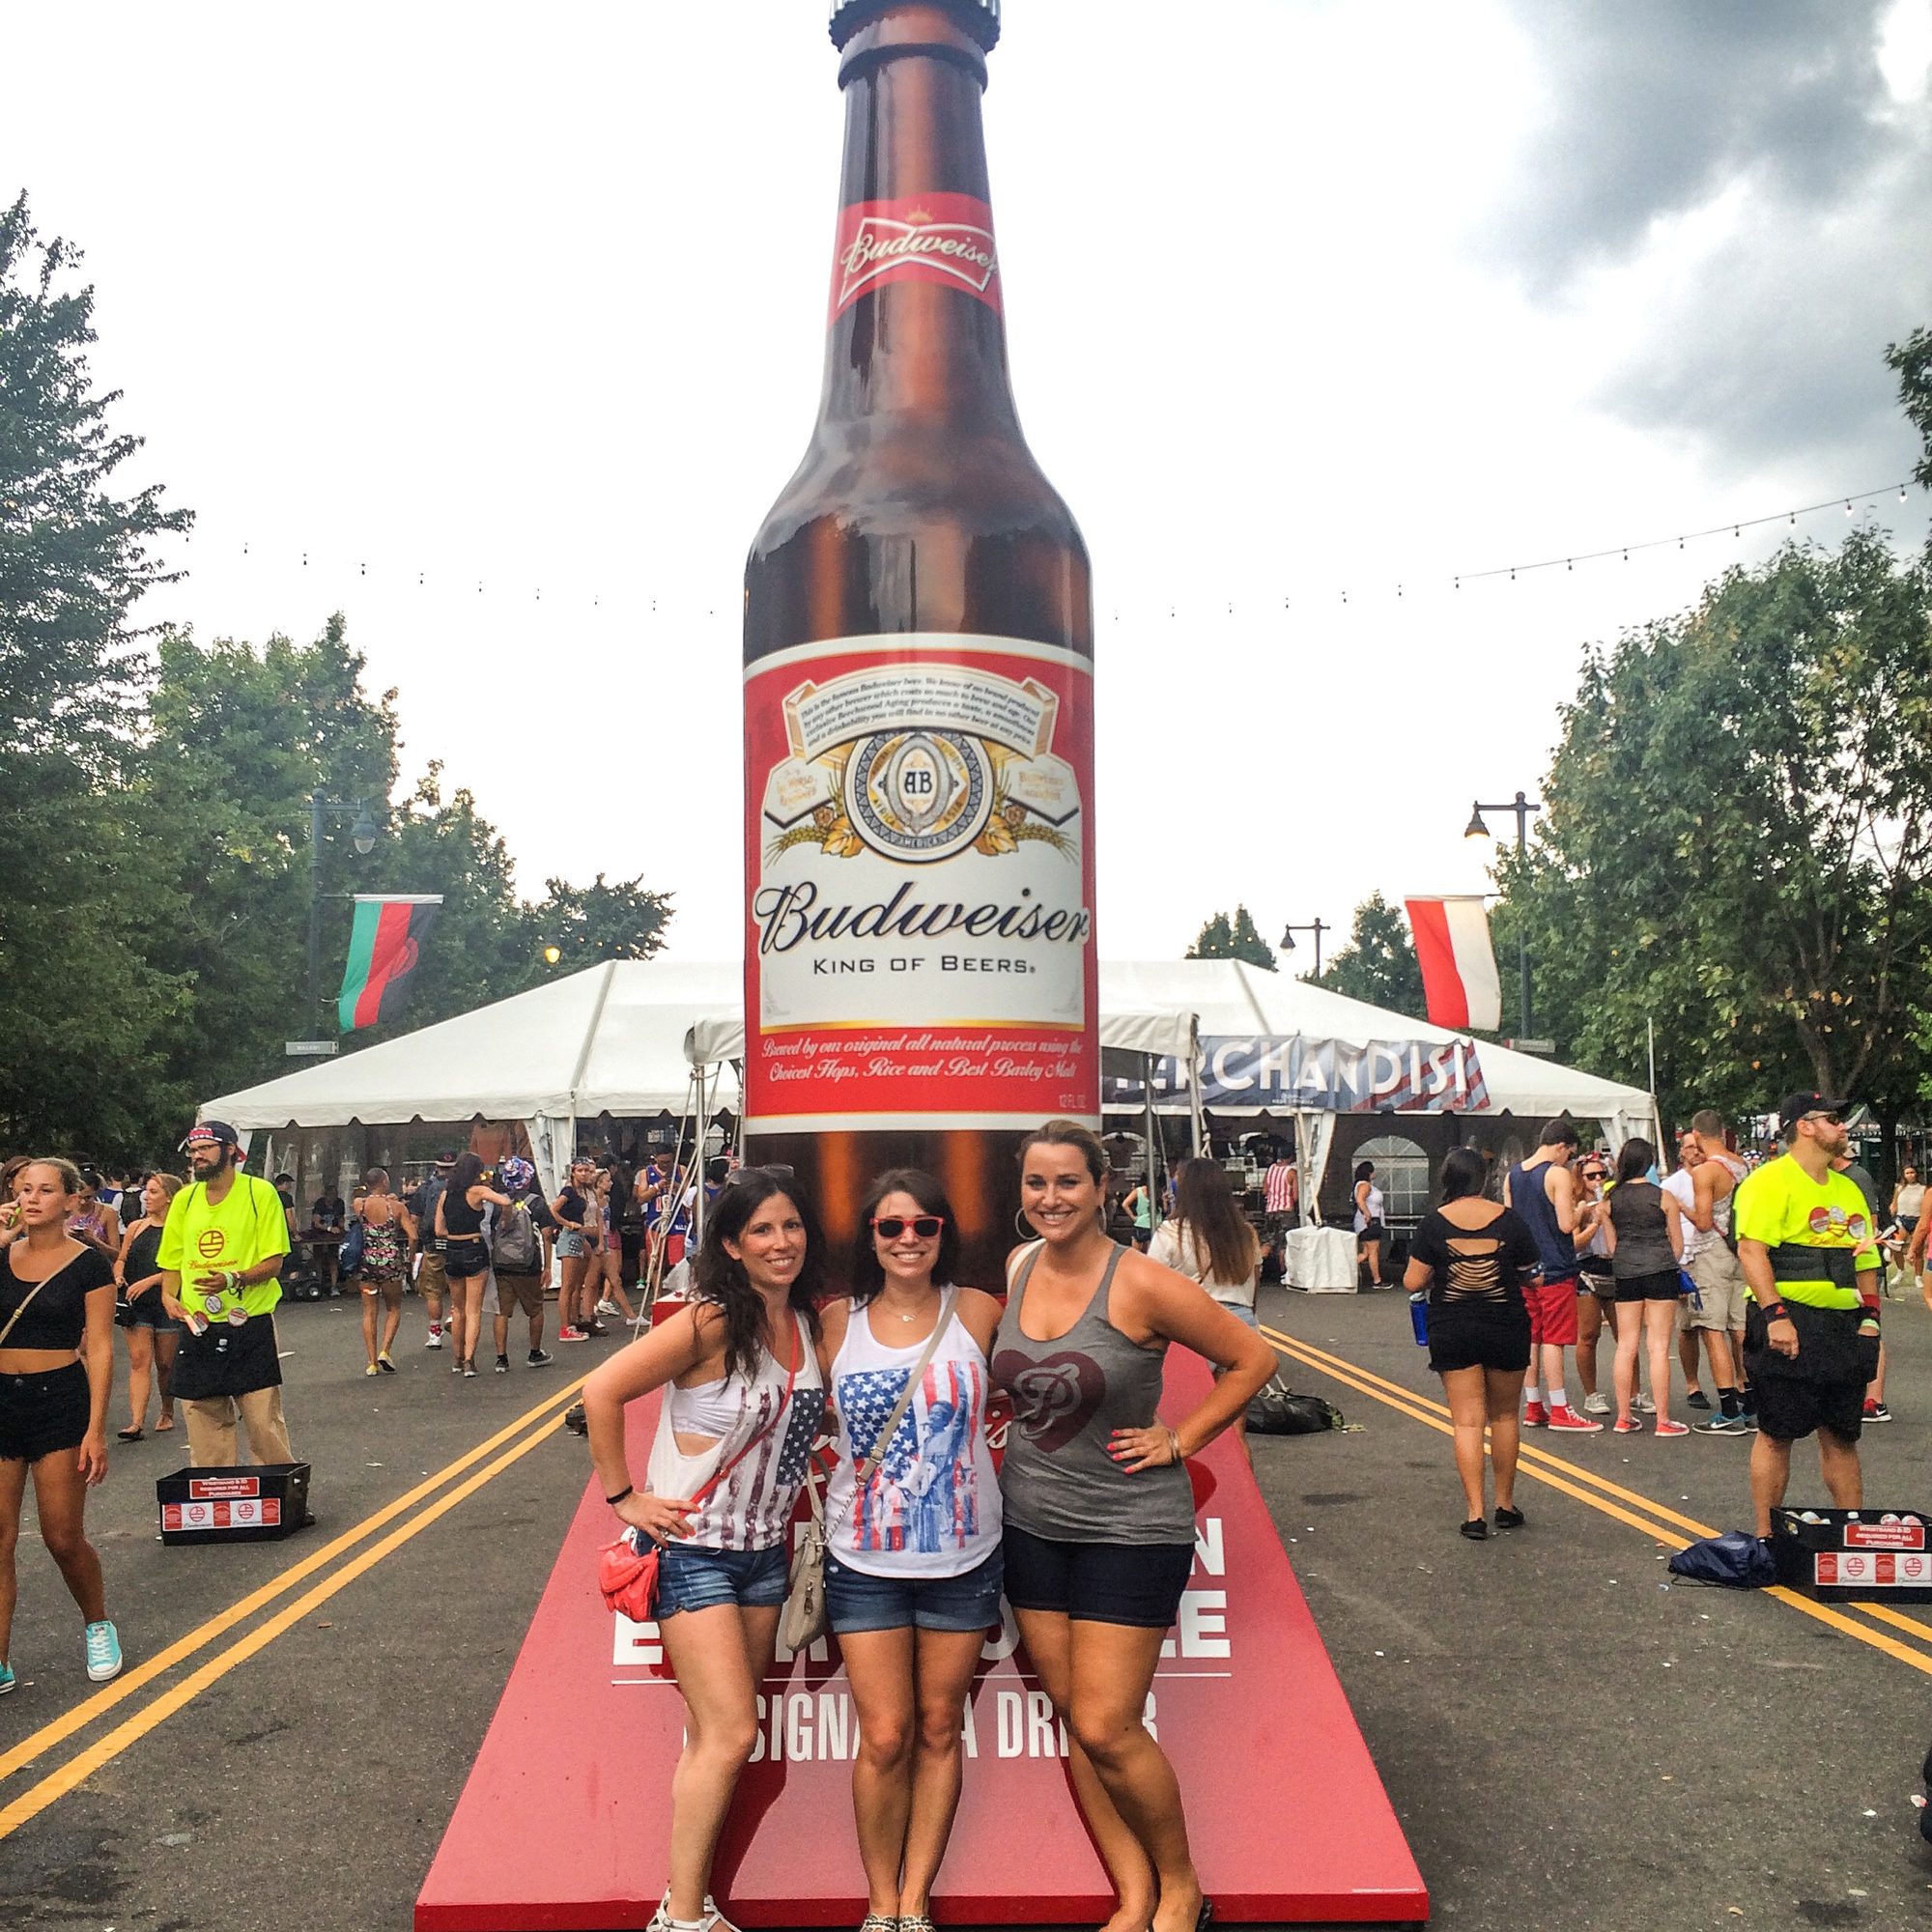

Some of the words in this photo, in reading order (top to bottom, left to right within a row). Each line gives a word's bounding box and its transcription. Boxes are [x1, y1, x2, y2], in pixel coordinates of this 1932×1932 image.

[839, 230, 998, 277] Budweiser
[904, 771, 933, 794] AB
[755, 881, 1089, 954] Budweiser
[814, 958, 874, 975] KING
[890, 957, 925, 972] OF
[761, 1037, 804, 1058] Brewed
[803, 1037, 818, 1059] by
[819, 1042, 842, 1054] our
[843, 1034, 908, 1057] original
[905, 1034, 932, 1051] all
[930, 1035, 993, 1053] natural
[985, 1038, 1037, 1057] process
[769, 1062, 814, 1082] Choicest
[863, 1057, 906, 1077] Rice
[907, 1059, 944, 1077] and
[944, 1056, 989, 1077] Best
[990, 1057, 1044, 1082] Barley
